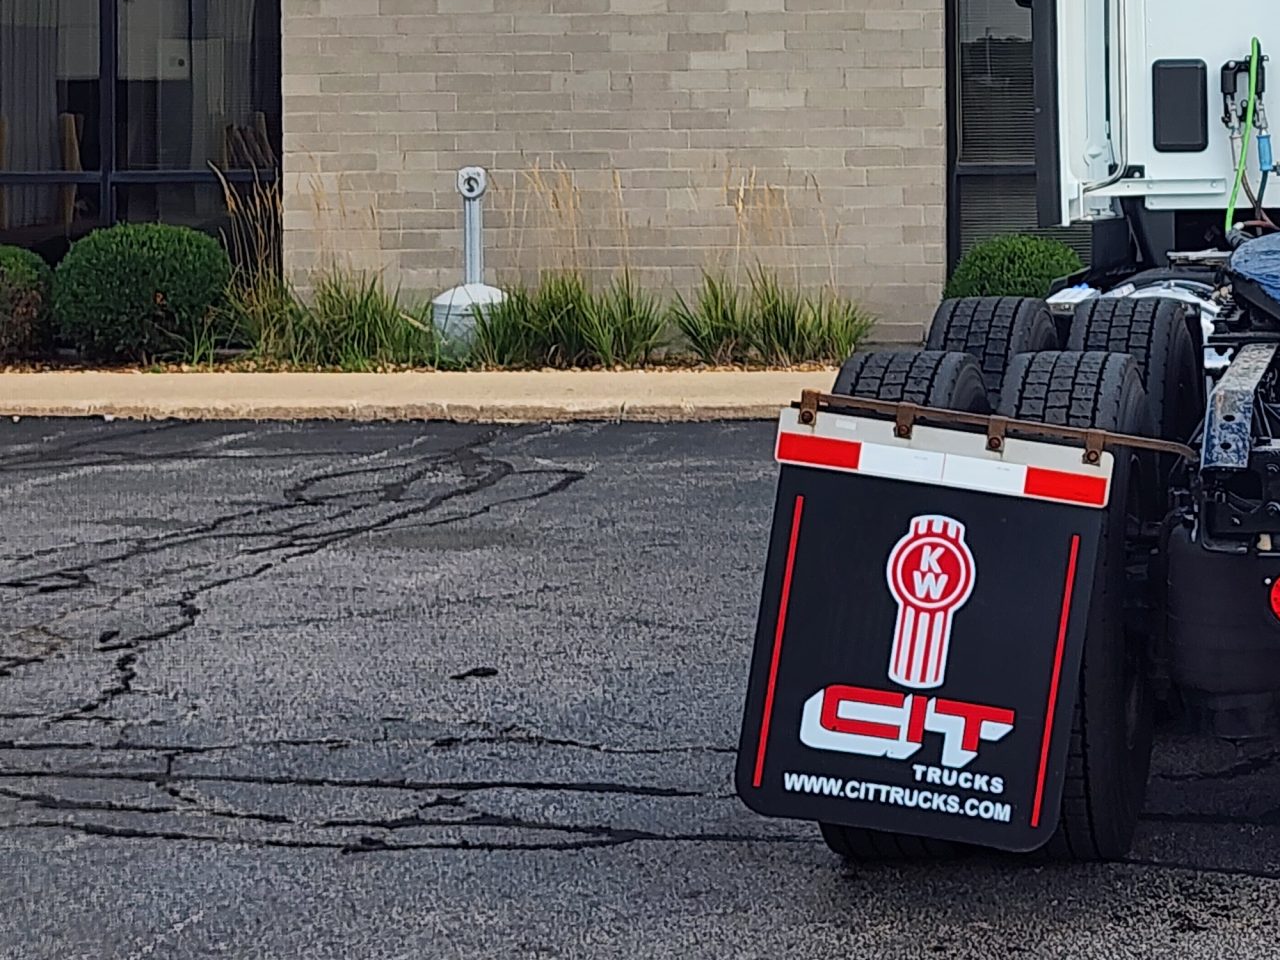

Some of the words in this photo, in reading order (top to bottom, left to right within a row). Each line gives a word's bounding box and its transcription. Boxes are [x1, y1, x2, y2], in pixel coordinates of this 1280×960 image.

[920, 545, 945, 574] K
[911, 571, 949, 601] W
[800, 685, 1015, 768] CIT
[913, 763, 1004, 794] TRUCKS
[783, 772, 1012, 823] WWW.CITTRUCKS.COM
